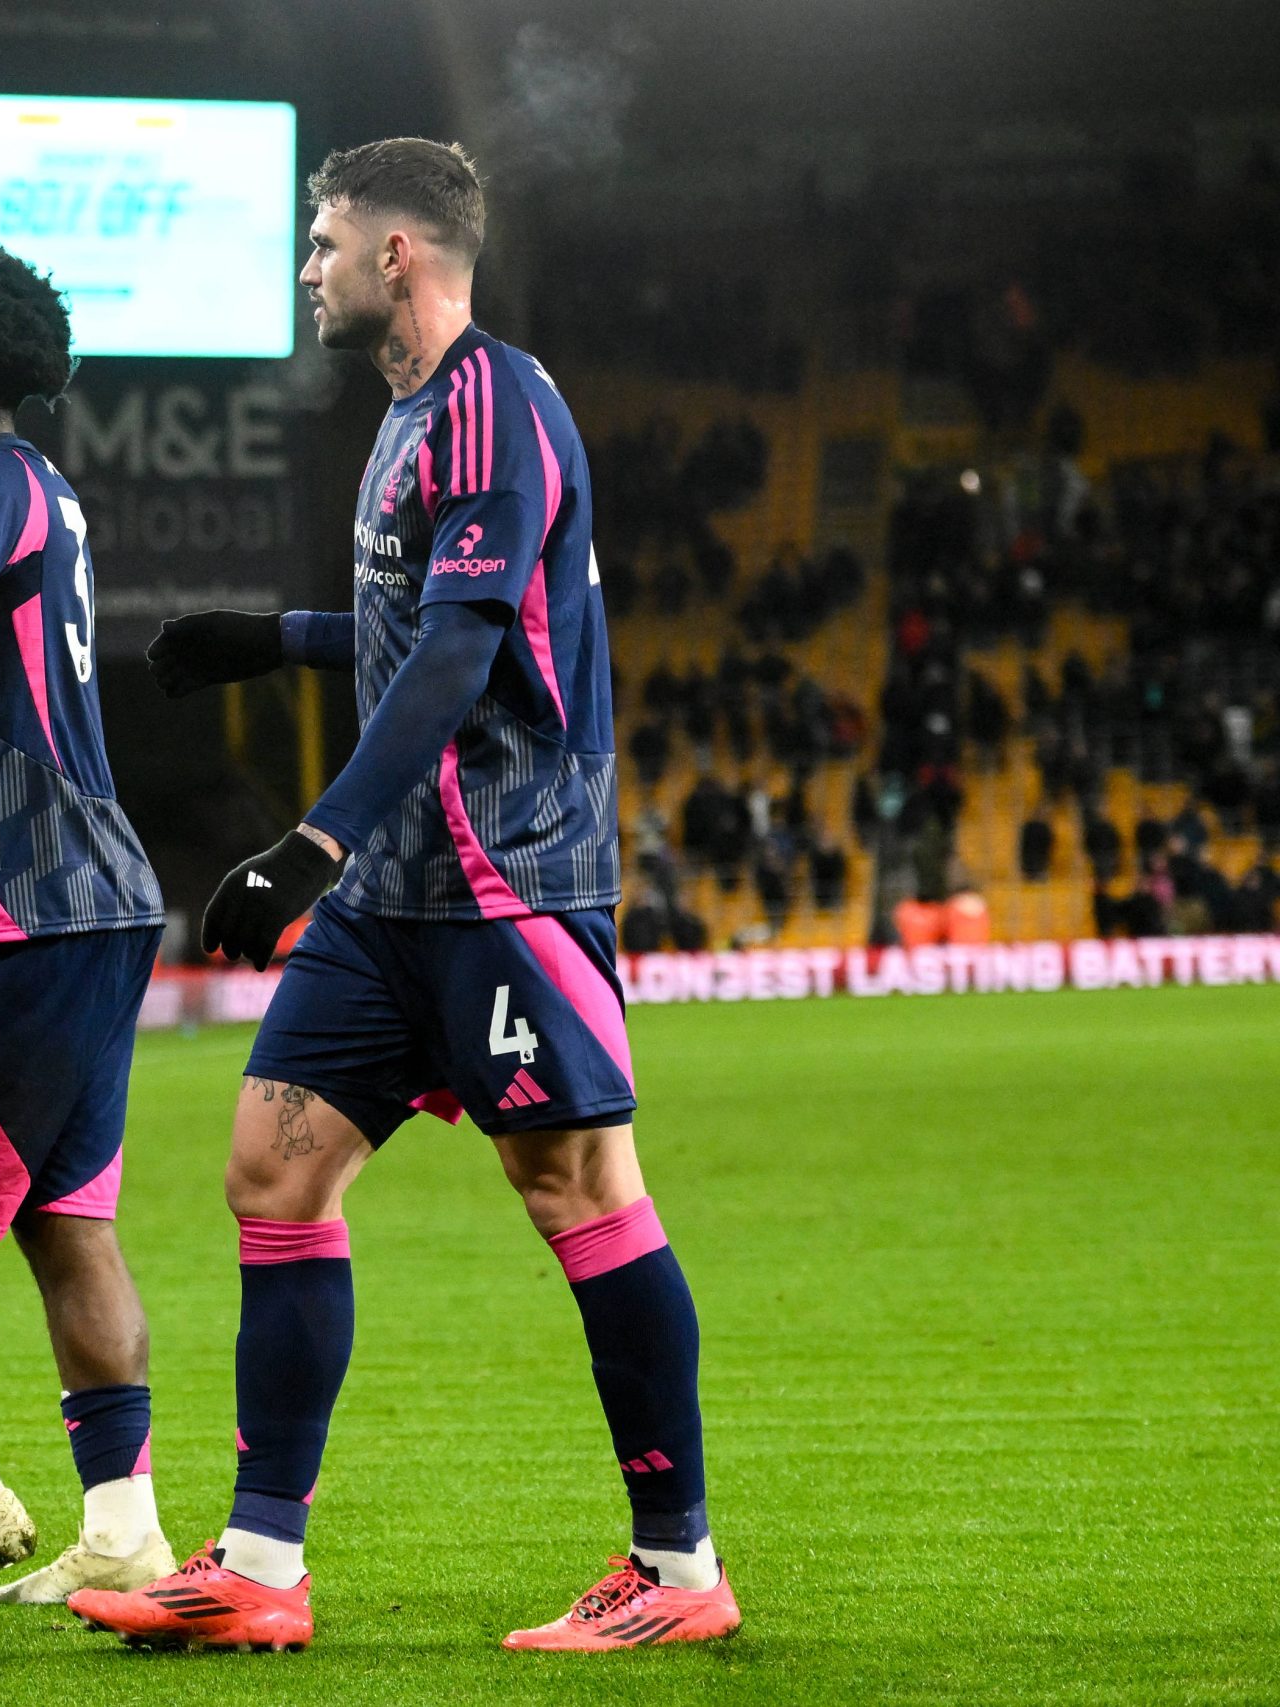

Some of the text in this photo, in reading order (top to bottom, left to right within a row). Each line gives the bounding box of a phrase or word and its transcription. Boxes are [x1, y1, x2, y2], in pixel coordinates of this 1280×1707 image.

[64, 385, 288, 480] M&E
[846, 941, 1065, 997] LASTING
[489, 984, 539, 1064] 4
